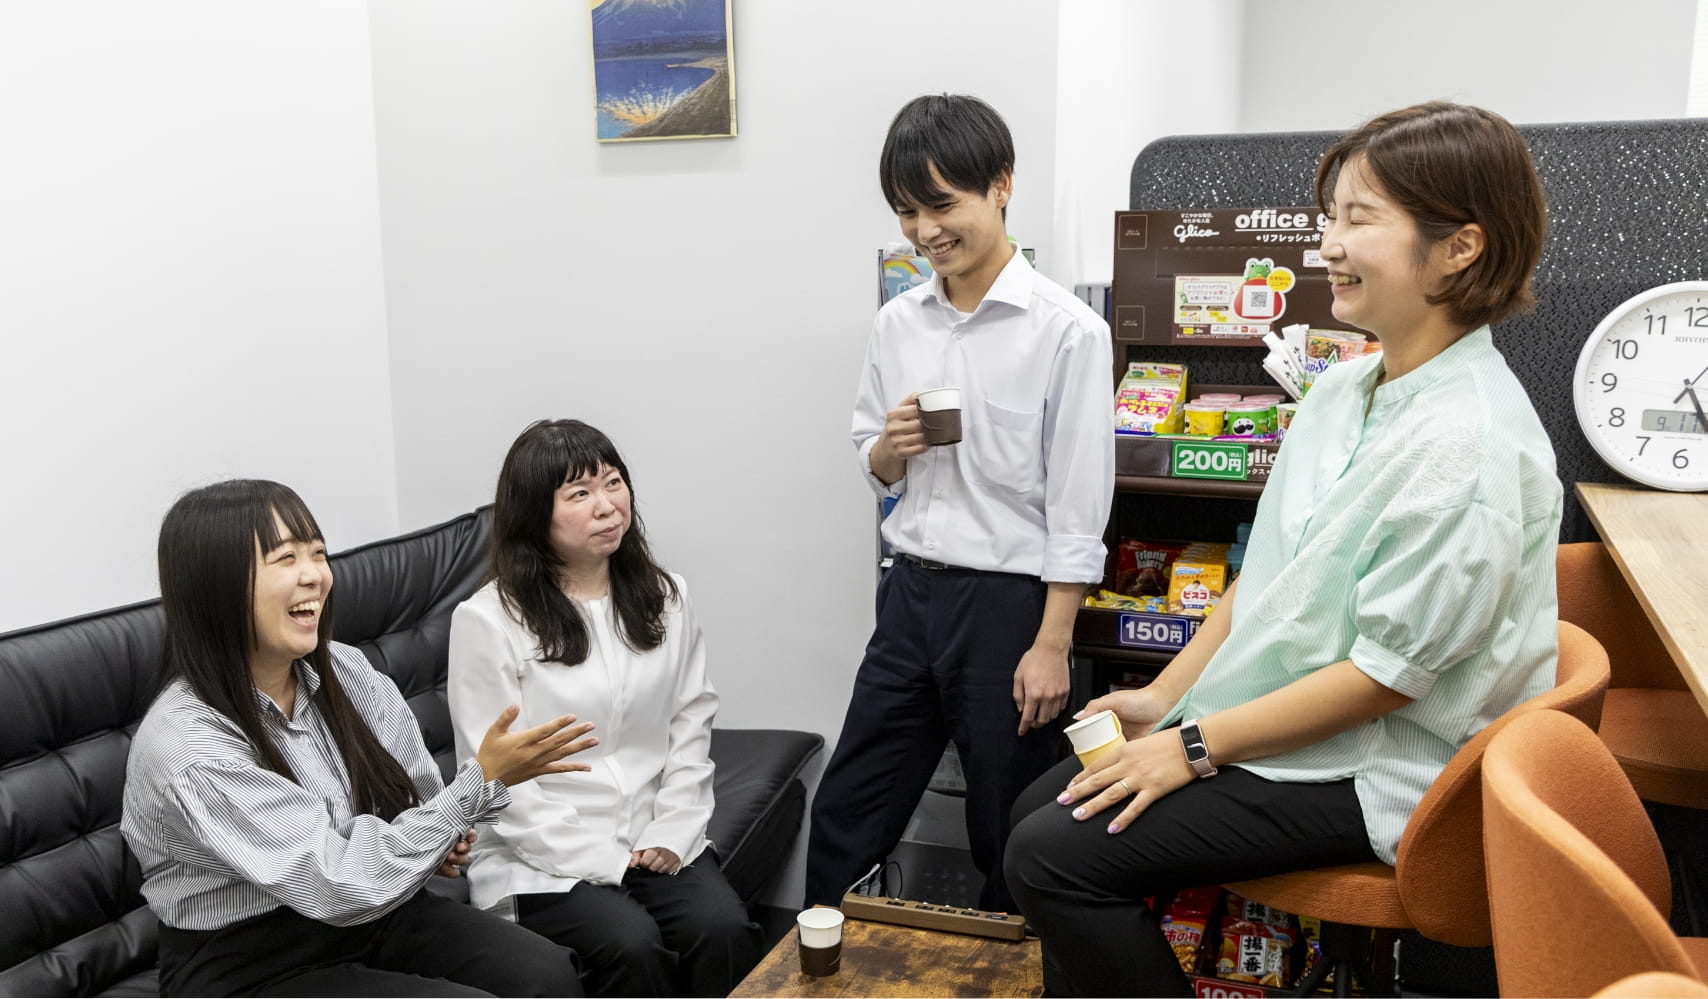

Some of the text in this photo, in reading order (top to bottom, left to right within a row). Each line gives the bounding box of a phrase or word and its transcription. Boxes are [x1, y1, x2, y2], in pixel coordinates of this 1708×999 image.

[1235, 209, 1309, 229] office
[1644, 314, 1667, 335] 11
[1684, 306, 1708, 328] 12
[1611, 339, 1639, 360] 10
[1601, 372, 1618, 393] 9
[1608, 407, 1625, 428] 8
[1635, 436, 1651, 456] 7
[1178, 449, 1242, 472] 200円
[1672, 449, 1689, 469] 6
[1183, 591, 1207, 600] ビスコ
[1125, 621, 1183, 643] 150円
[1243, 936, 1263, 972] 揚一番
